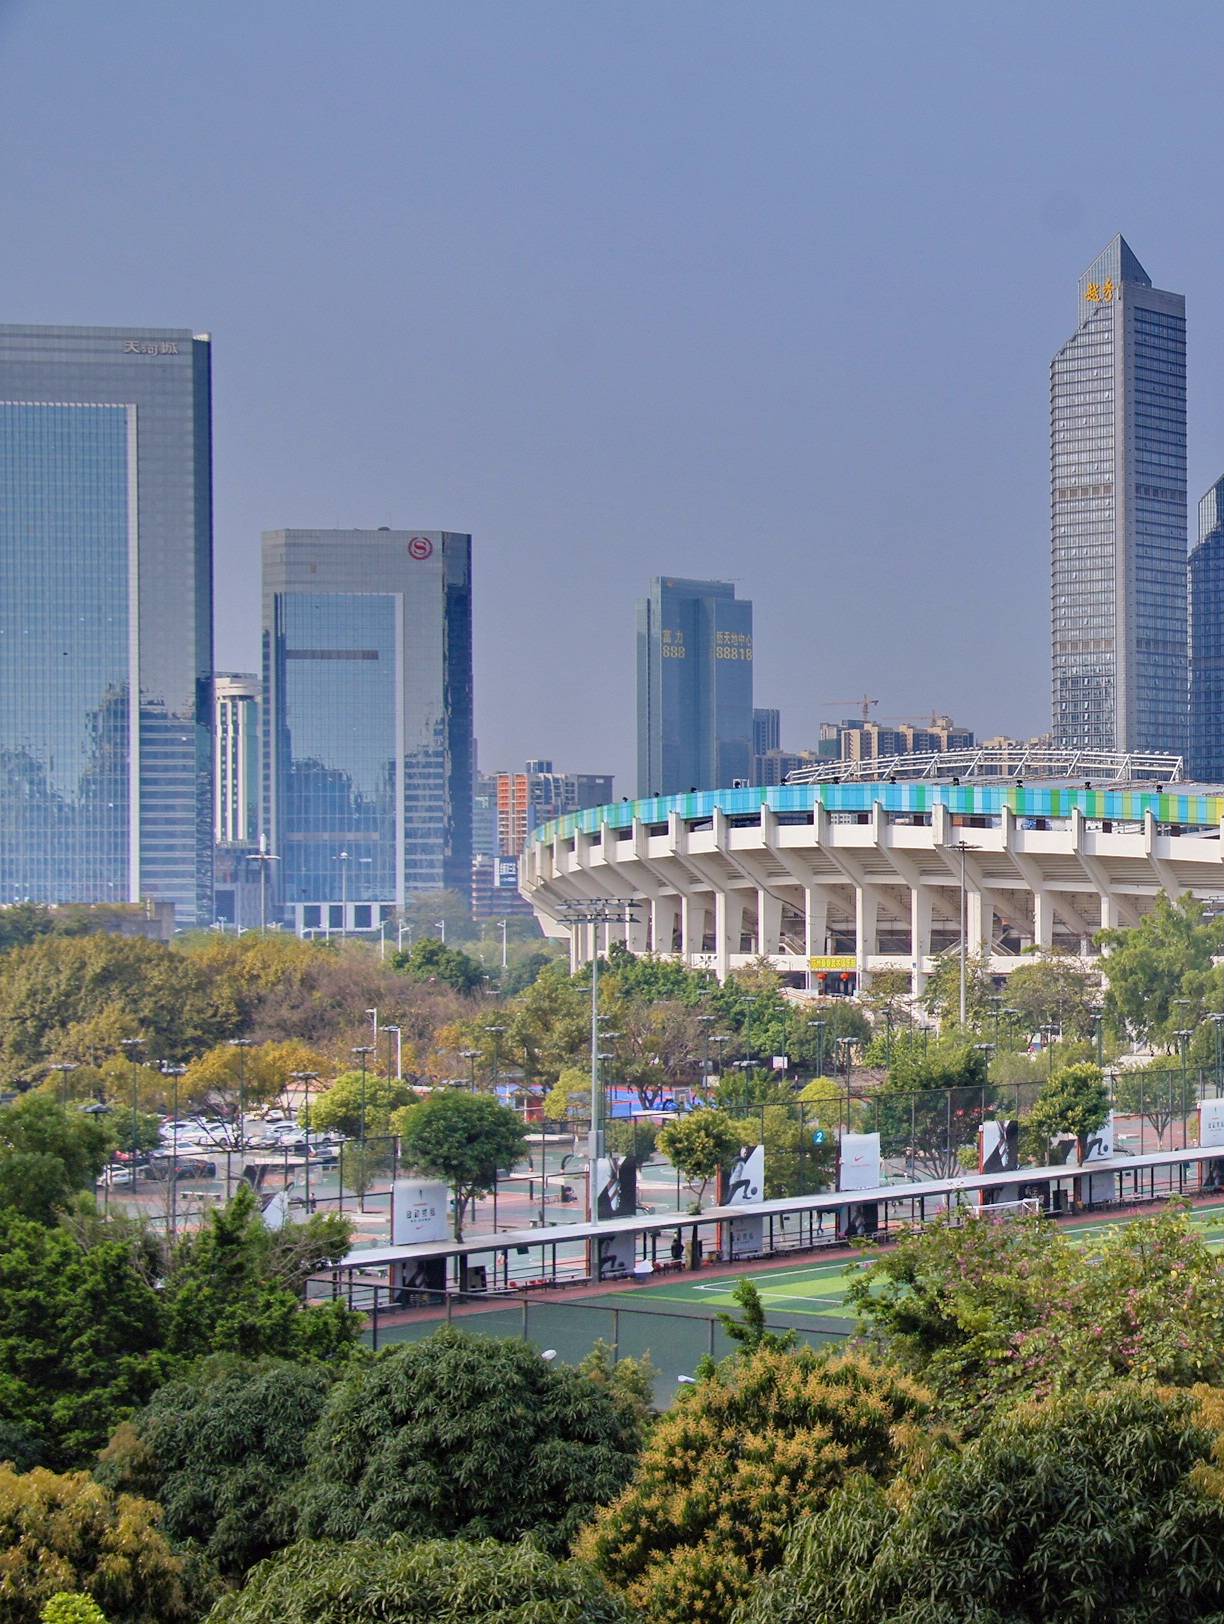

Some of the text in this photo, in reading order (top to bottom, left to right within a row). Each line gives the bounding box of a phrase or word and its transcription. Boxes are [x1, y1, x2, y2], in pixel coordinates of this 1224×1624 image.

[1085, 277, 1114, 303] 越秀
[124, 340, 179, 356] 天河城
[816, 1132, 823, 1143] 2
